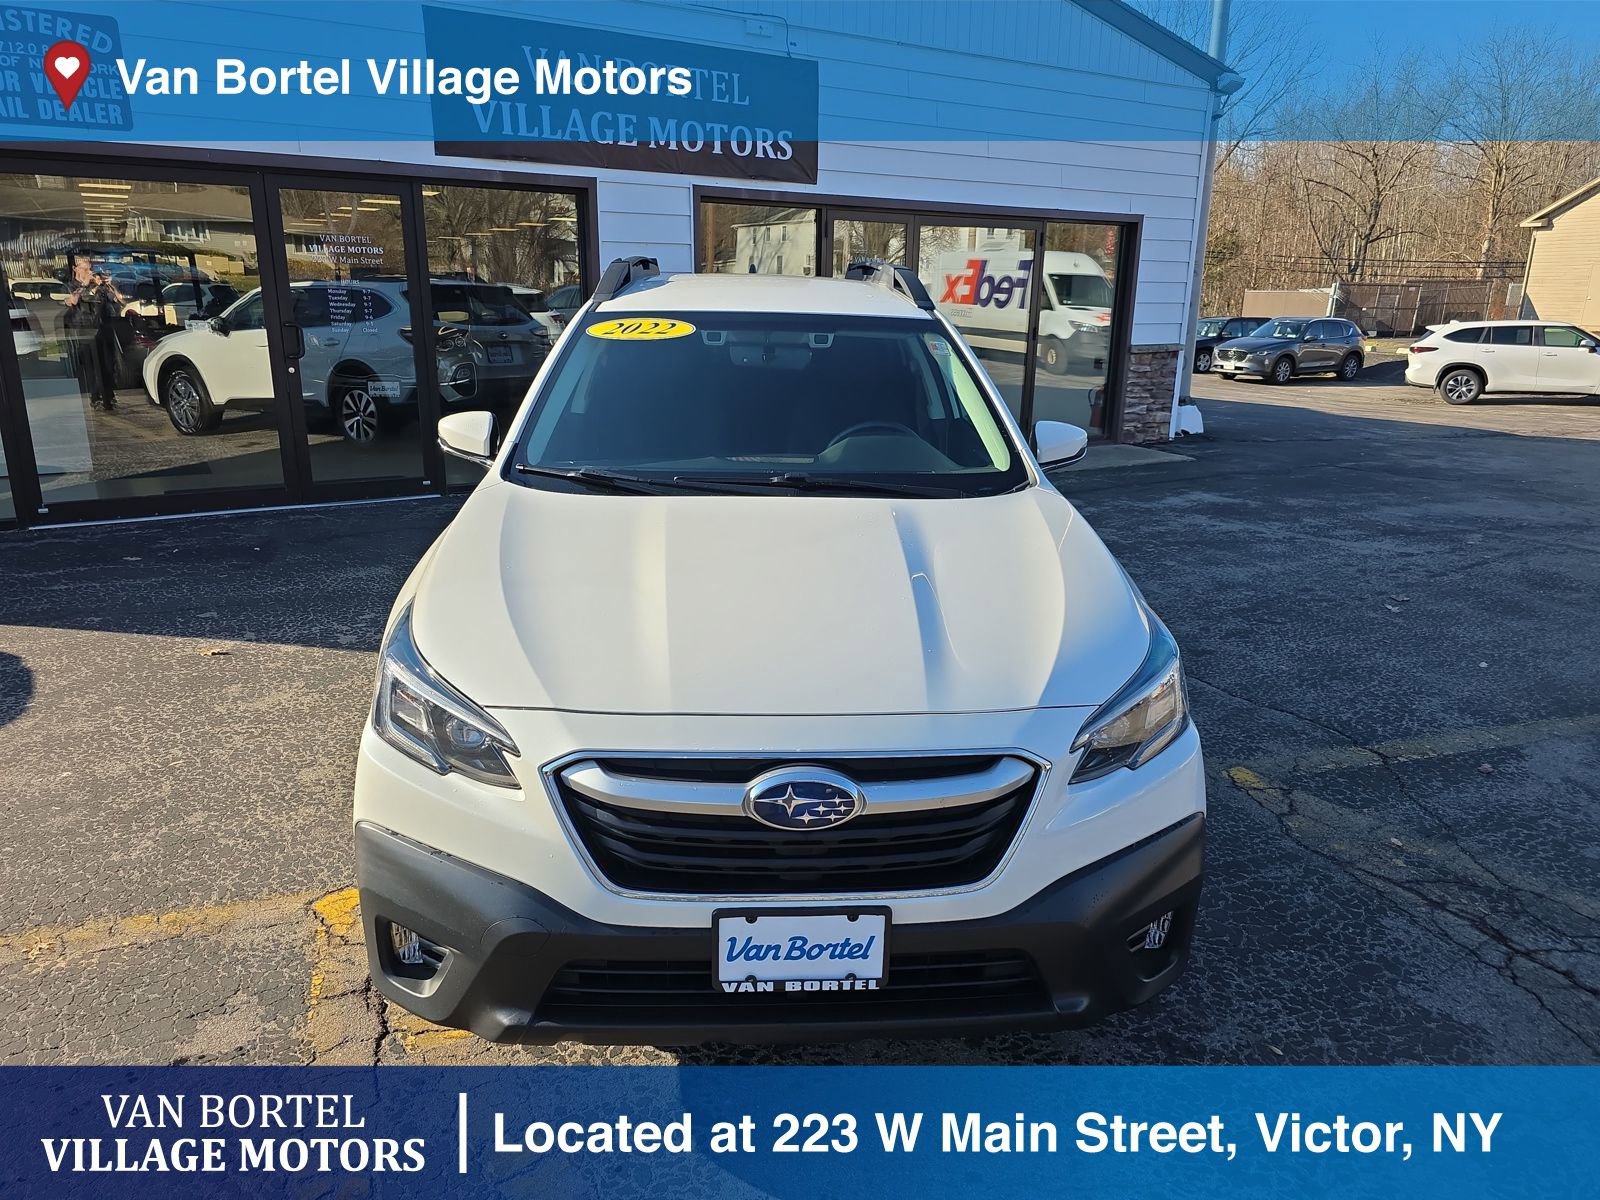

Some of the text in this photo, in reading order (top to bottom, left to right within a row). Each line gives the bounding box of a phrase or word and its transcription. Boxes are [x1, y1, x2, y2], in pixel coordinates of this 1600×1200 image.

[30, 71, 122, 100] VCLE
[37, 98, 123, 125] DEALER
[470, 100, 794, 161] VILLAGE MOTORS
[319, 234, 372, 244] VAN BORTEL
[308, 244, 384, 255] VILLAGE MOTORS
[329, 255, 338, 263] W
[339, 256, 359, 264] Main
[360, 256, 384, 265] Street
[602, 322, 677, 335] 2022
[721, 979, 880, 993] VAN BORTEL
